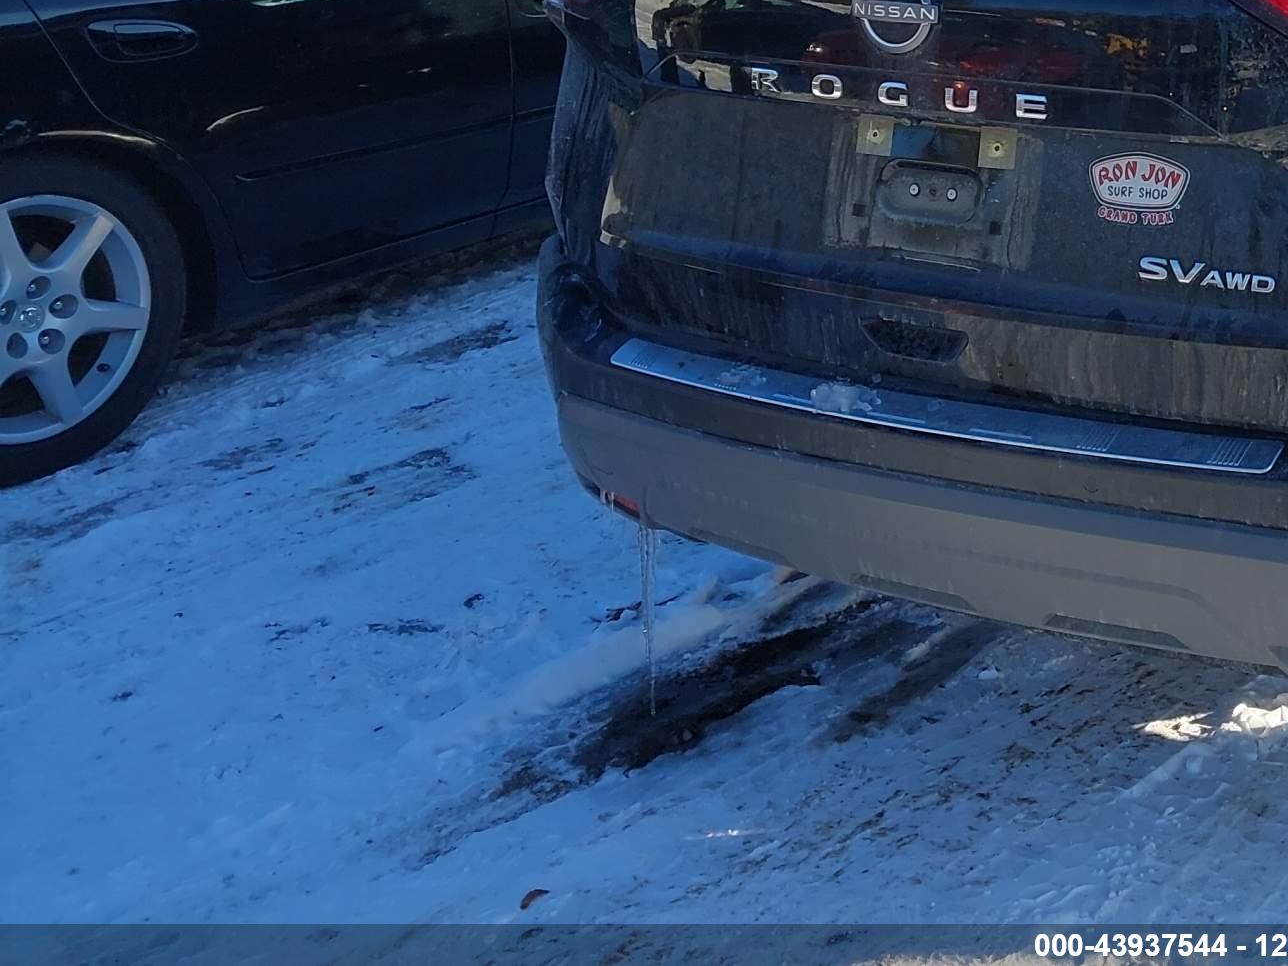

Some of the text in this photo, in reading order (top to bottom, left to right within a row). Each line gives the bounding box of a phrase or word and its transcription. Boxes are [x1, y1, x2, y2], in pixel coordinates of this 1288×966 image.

[853, 0, 938, 22] NISSAN
[750, 67, 1049, 120] ROGUE
[1098, 160, 1182, 190] RON JON
[1107, 185, 1168, 200] SURF SHOP
[1098, 206, 1174, 226] GRAND TURK
